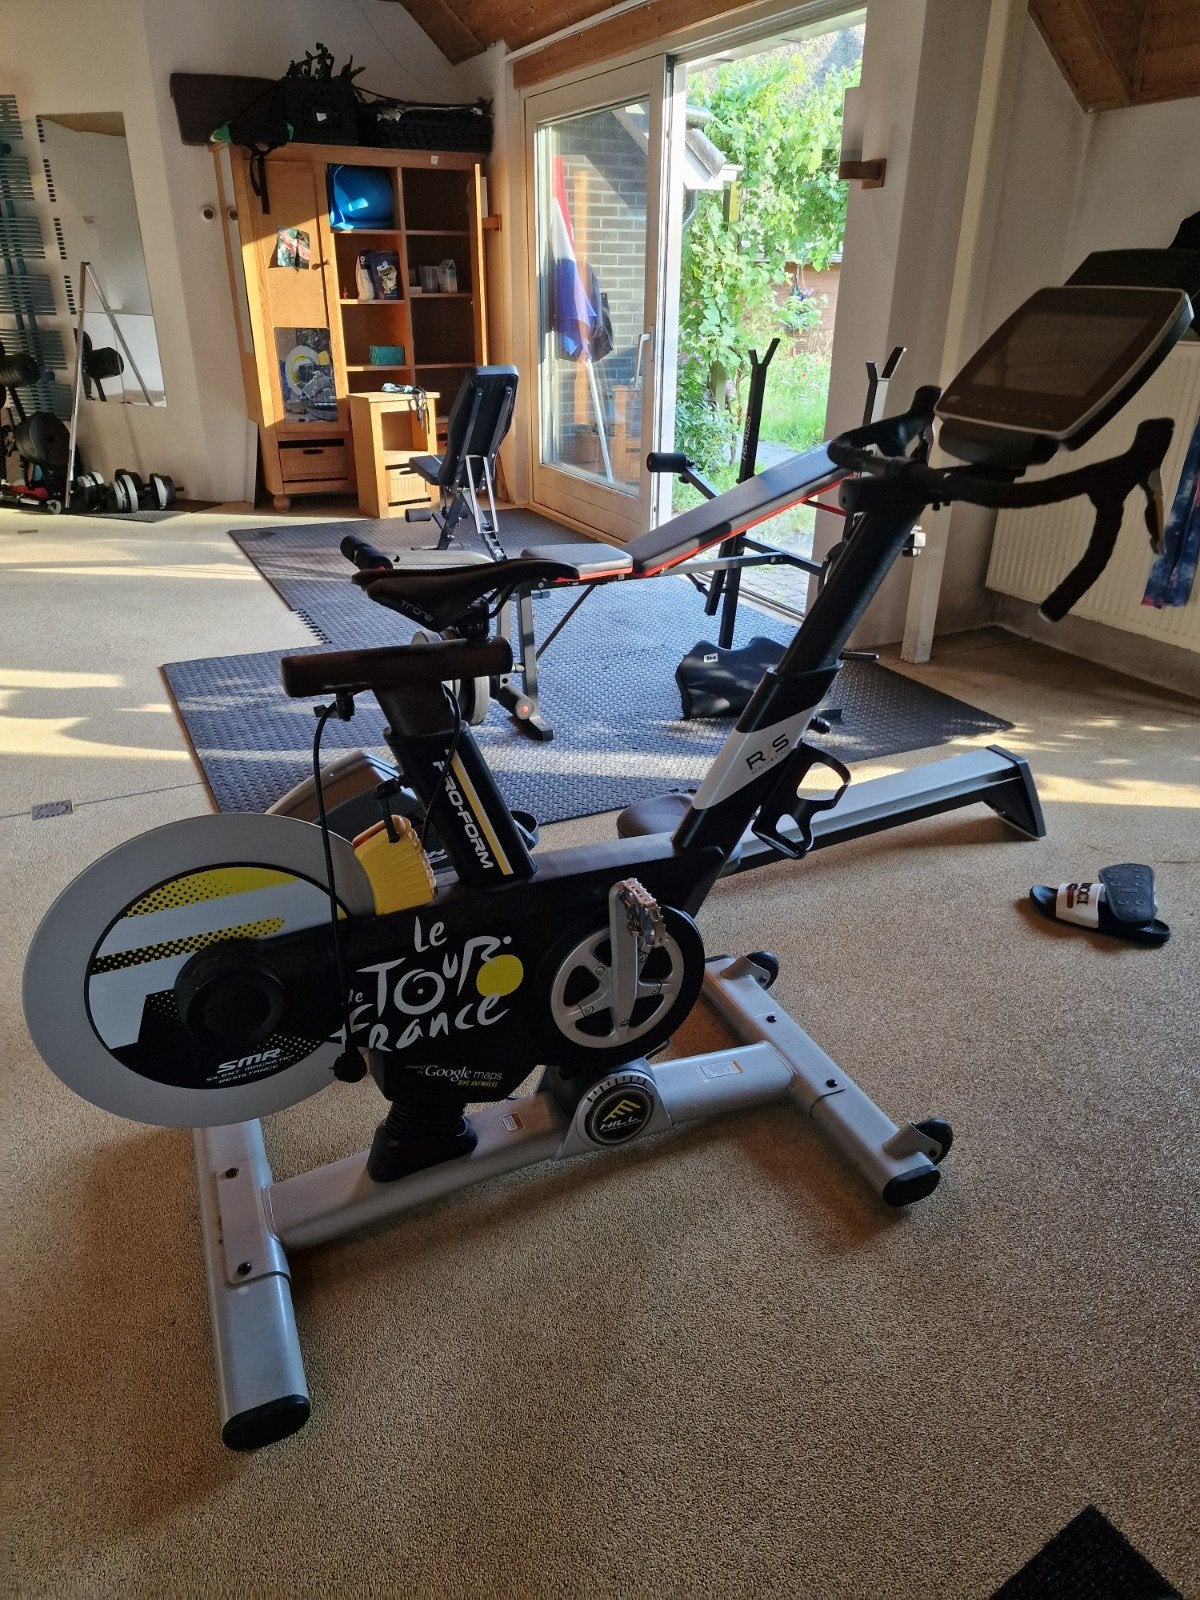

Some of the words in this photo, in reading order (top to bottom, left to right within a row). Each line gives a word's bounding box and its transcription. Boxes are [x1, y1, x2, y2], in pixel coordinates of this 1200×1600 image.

[432, 760, 494, 869] PRO-FORM
[413, 915, 448, 953] Le
[216, 1047, 281, 1074] SMR
[425, 1065, 472, 1082] Google
[473, 1070, 504, 1081] maps
[471, 1080, 499, 1088] ANYWHERE
